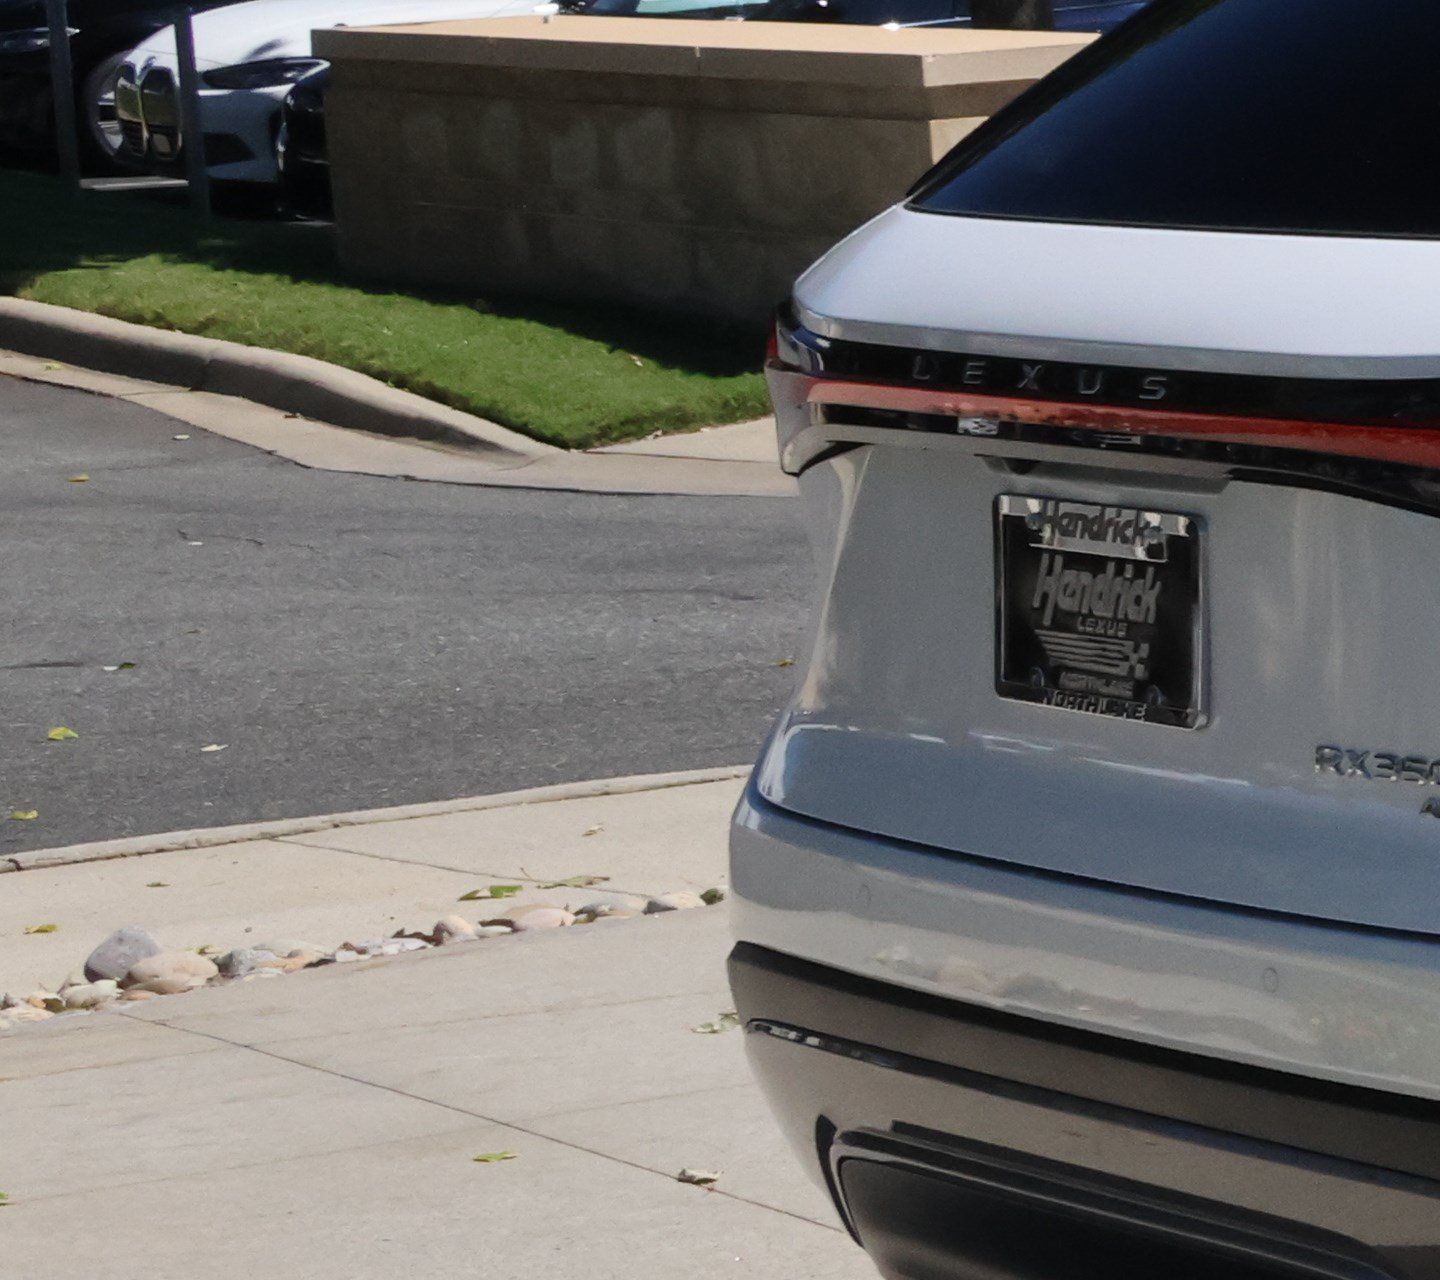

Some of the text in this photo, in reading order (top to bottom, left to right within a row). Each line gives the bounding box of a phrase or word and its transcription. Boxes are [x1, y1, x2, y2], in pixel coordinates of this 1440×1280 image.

[911, 354, 1168, 401] LEXUS
[1031, 551, 1162, 626] Hendrick
[1076, 616, 1129, 637] LEXUS
